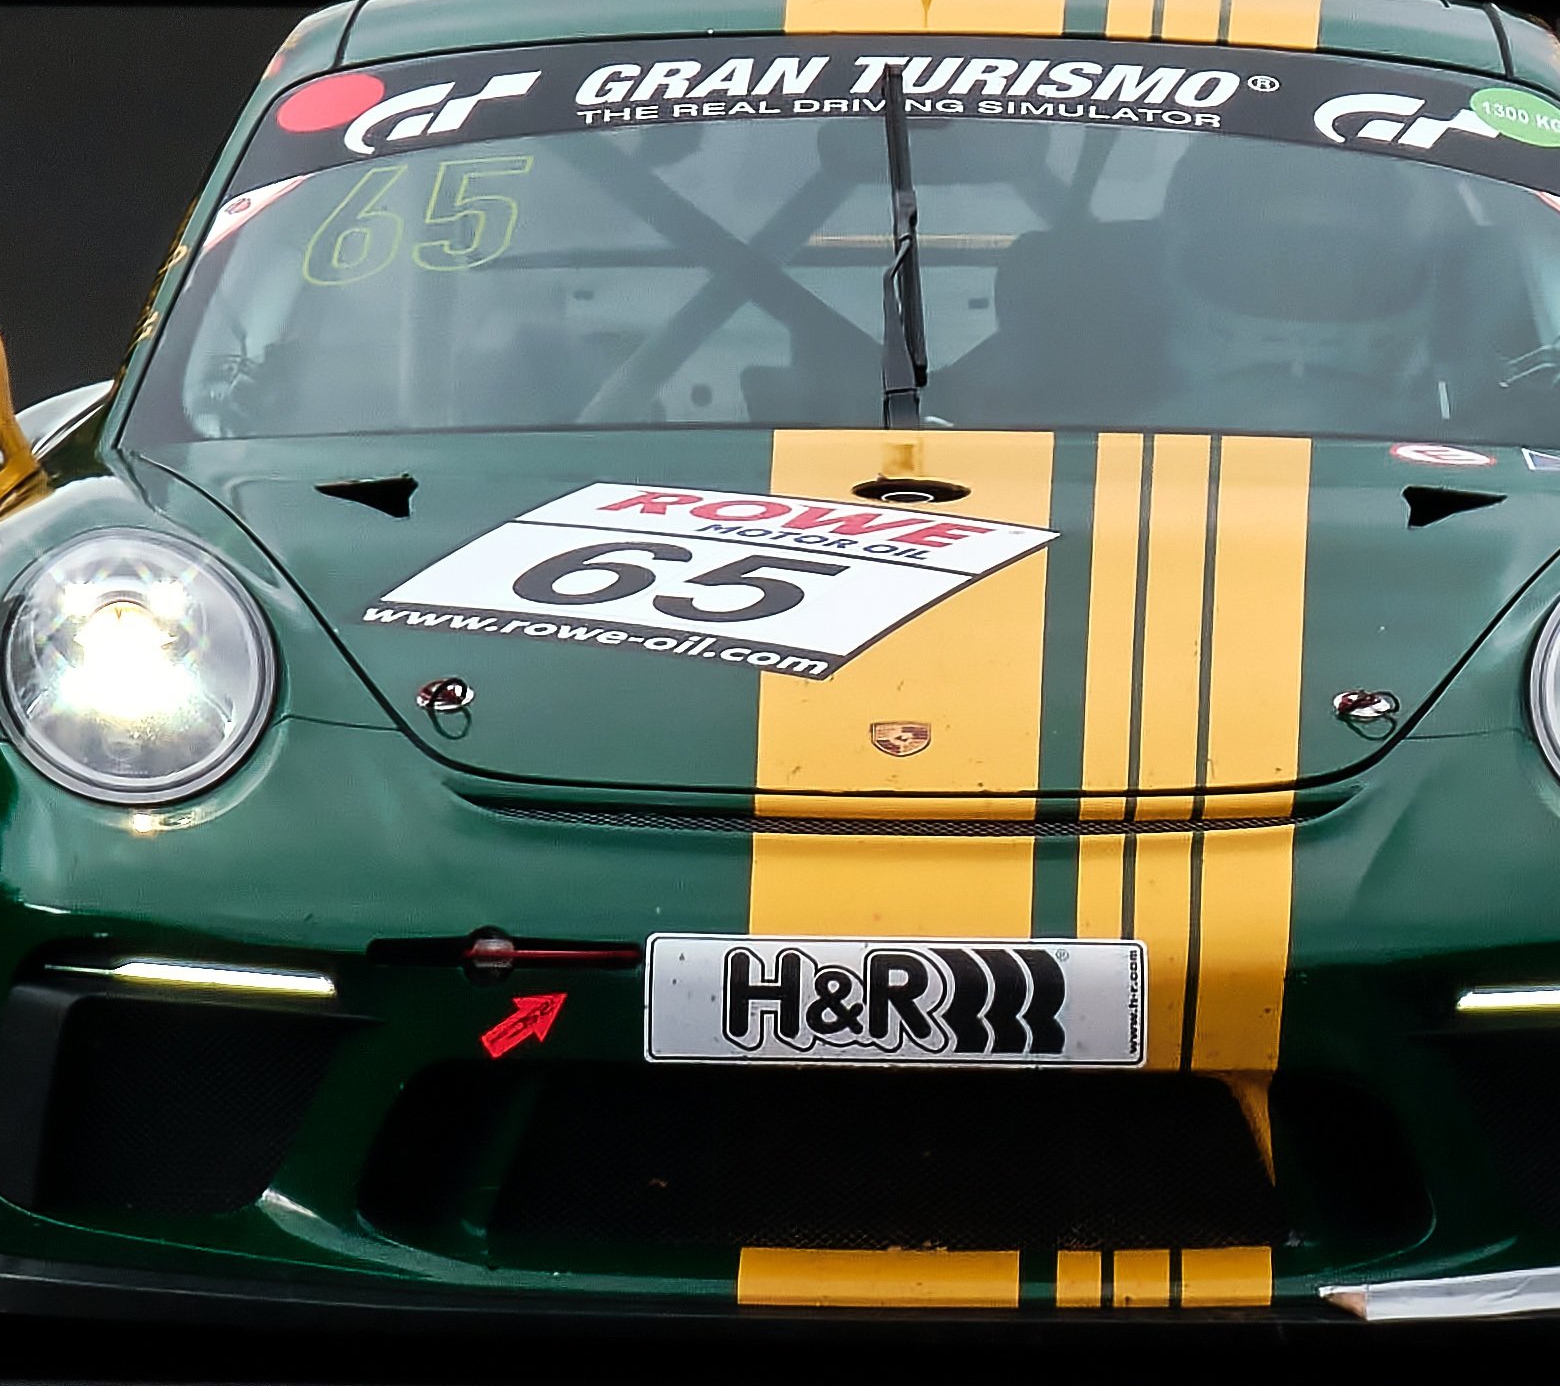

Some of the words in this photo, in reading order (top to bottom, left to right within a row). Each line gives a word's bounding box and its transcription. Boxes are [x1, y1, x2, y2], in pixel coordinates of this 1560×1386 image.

[575, 56, 830, 107] GRAN
[577, 104, 659, 125] THE
[672, 99, 781, 120] REAL
[793, 97, 965, 115] DRIVNG
[977, 99, 1221, 128] SIMULATOR
[1482, 100, 1529, 124] 1300
[302, 155, 535, 287] 65
[595, 490, 997, 549] ROWE
[696, 524, 848, 550] MOTOR
[862, 545, 931, 562] OIL
[512, 541, 851, 623] 65
[362, 606, 830, 677] www.rowe-oil.com
[723, 947, 949, 1053] H&R
